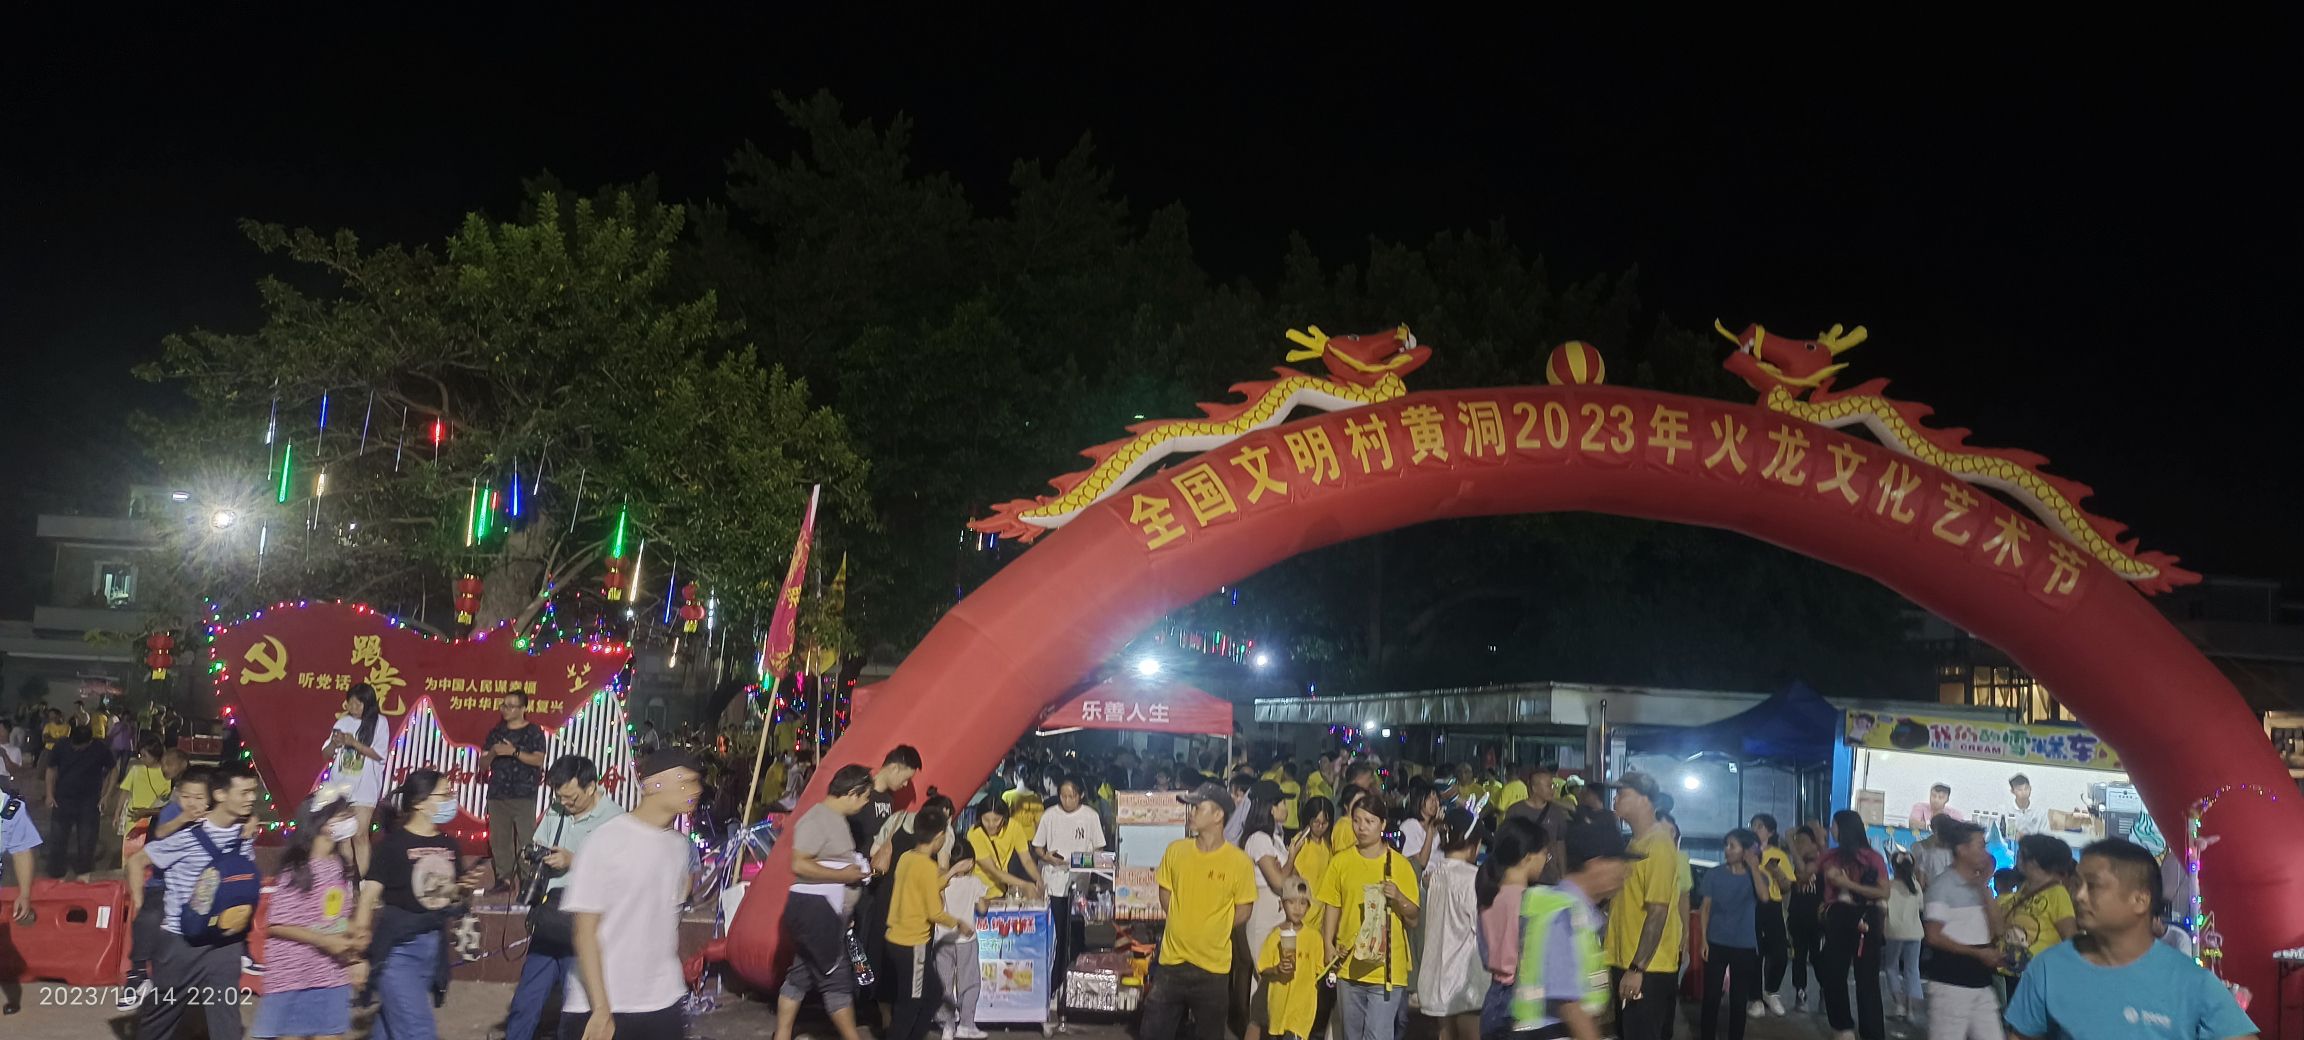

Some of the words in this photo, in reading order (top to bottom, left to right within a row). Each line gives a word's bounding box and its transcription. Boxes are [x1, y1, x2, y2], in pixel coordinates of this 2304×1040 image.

[1130, 400, 2088, 597] 全国文明村黄洞2023年火龙文化艺术节
[298, 672, 352, 692] 听党话
[425, 677, 538, 695] 为中国人民谋幸福
[1082, 700, 1170, 723] 乐善人生
[1930, 740, 1950, 750] ICE
[1960, 743, 2001, 755] CREAM
